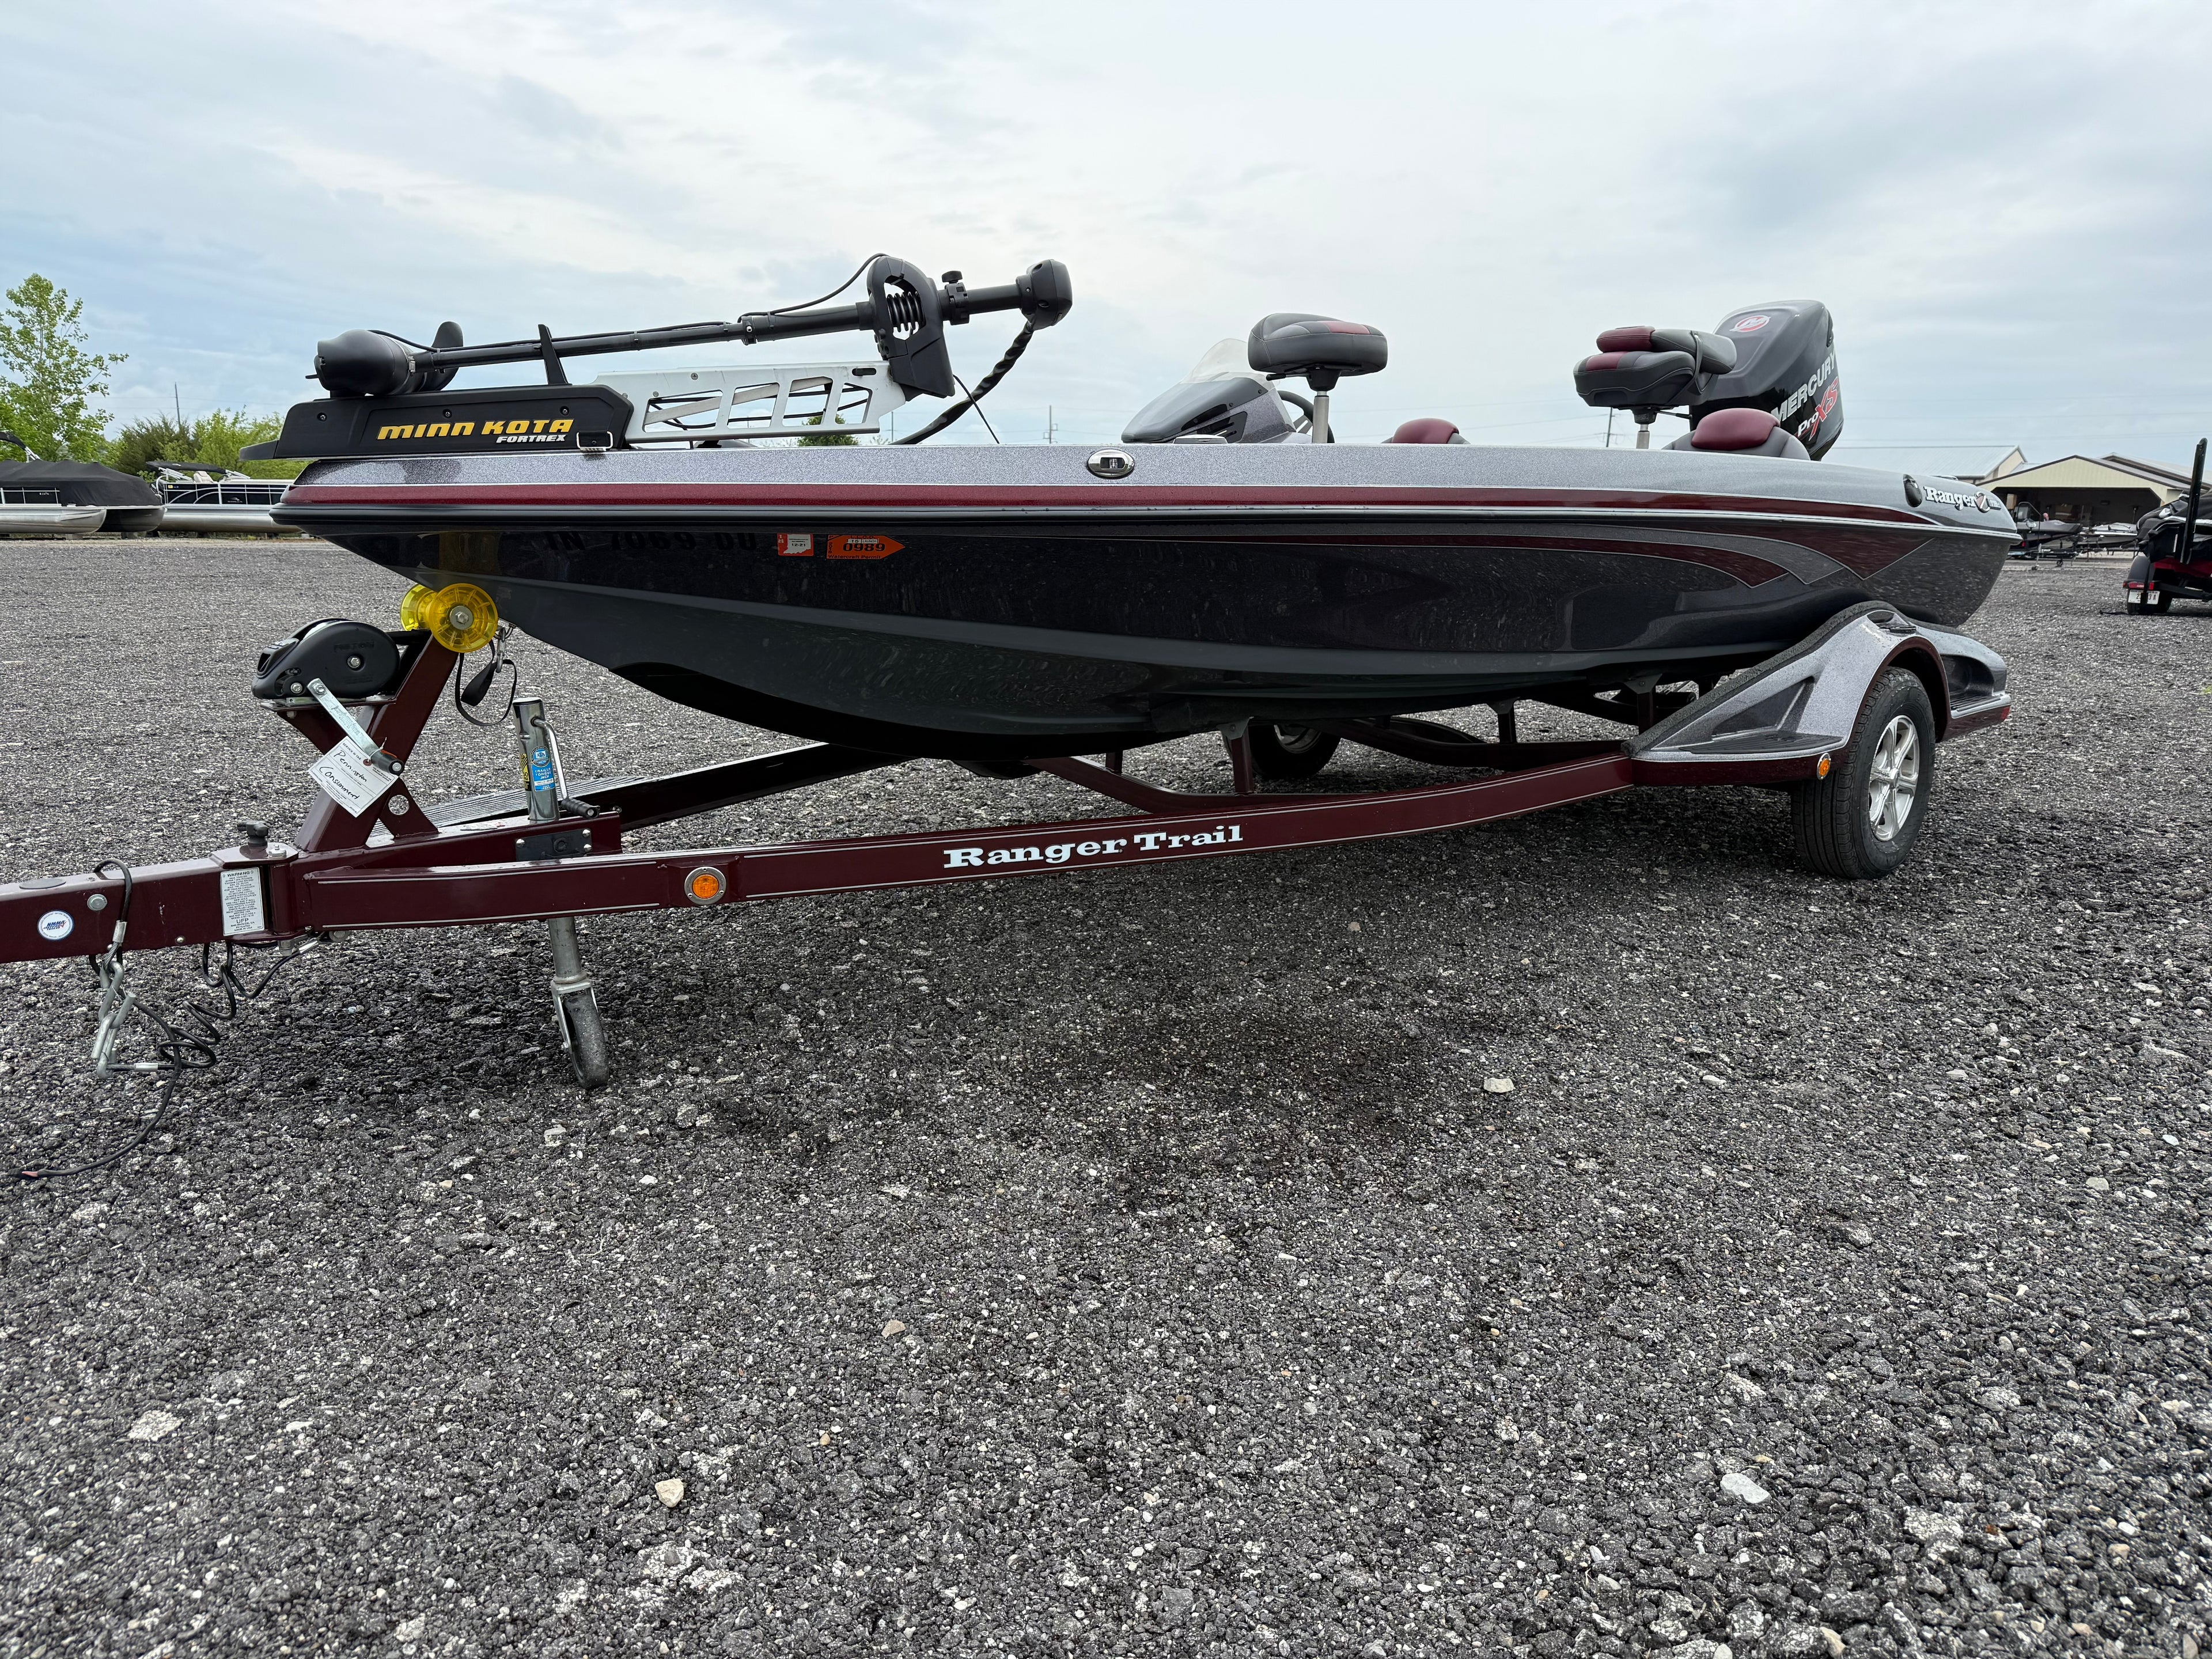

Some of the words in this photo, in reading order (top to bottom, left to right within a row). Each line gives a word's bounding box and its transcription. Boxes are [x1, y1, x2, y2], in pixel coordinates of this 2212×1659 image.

[1771, 350, 1835, 421] MERCURY
[377, 422, 475, 440] MINN
[482, 419, 574, 435] KOTA
[496, 434, 566, 443] FORTREX
[1923, 486, 1977, 510] Ranger
[843, 543, 885, 551] 0989
[943, 838, 1127, 868] Ranger
[1134, 824, 1243, 851] Trail
